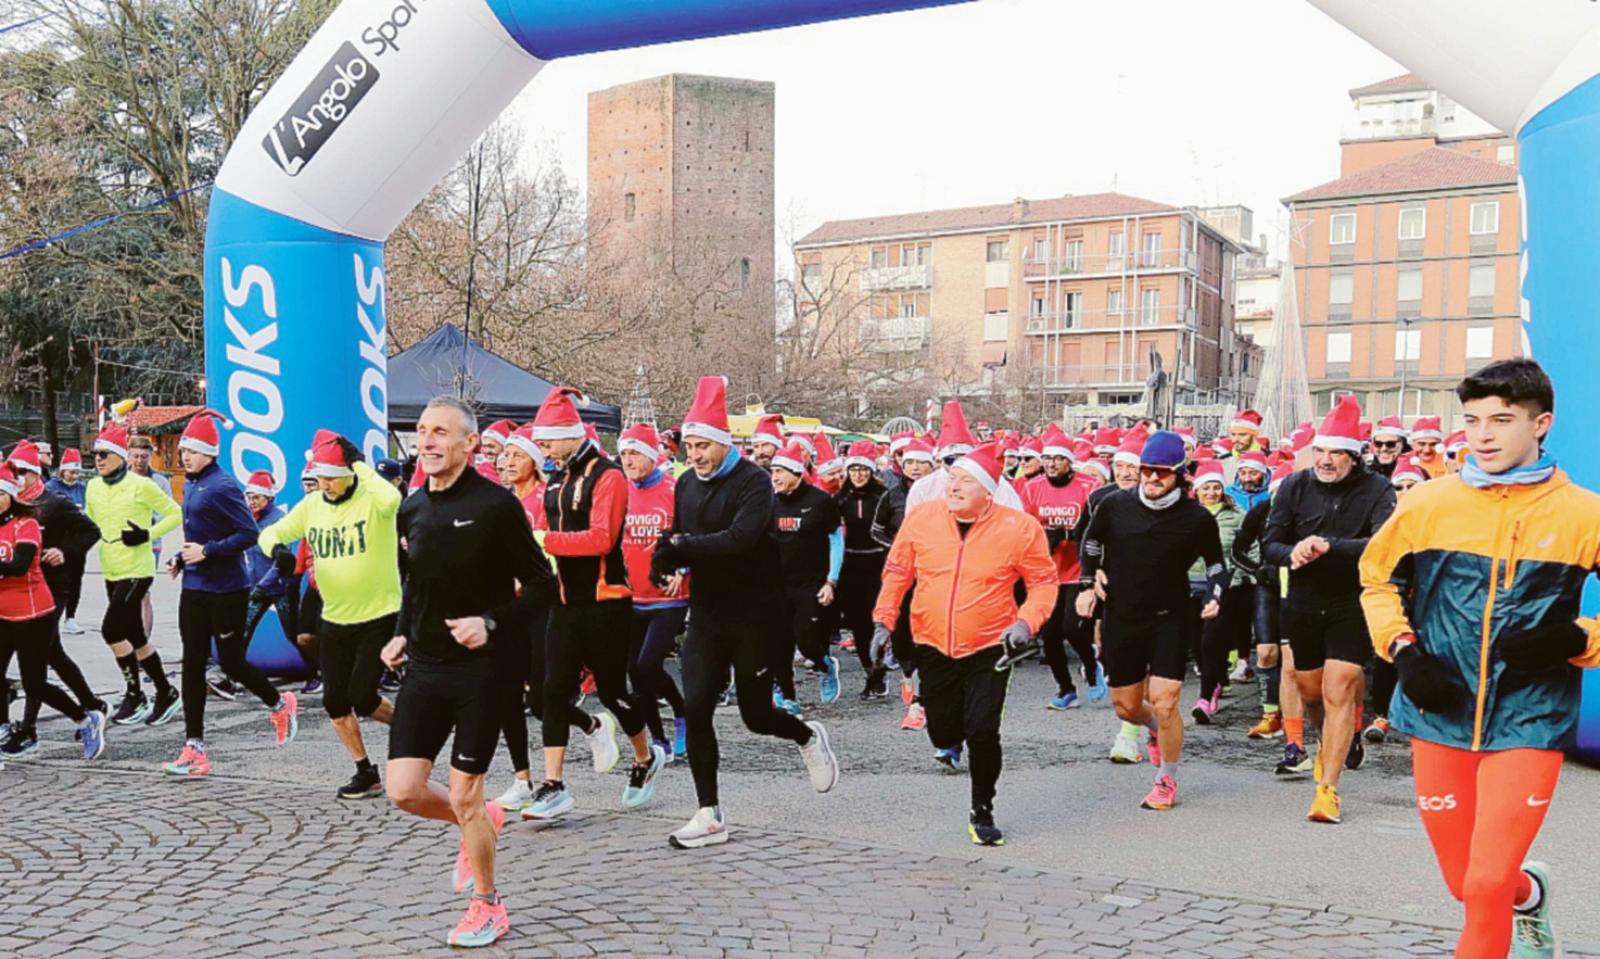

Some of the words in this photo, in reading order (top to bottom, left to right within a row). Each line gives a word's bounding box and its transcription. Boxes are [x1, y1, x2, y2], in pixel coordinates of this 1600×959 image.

[268, 58, 367, 176] L'Angolo
[1038, 506, 1075, 517] ROVIGO
[625, 514, 662, 527] OVIGO
[630, 526, 663, 538] LOVE
